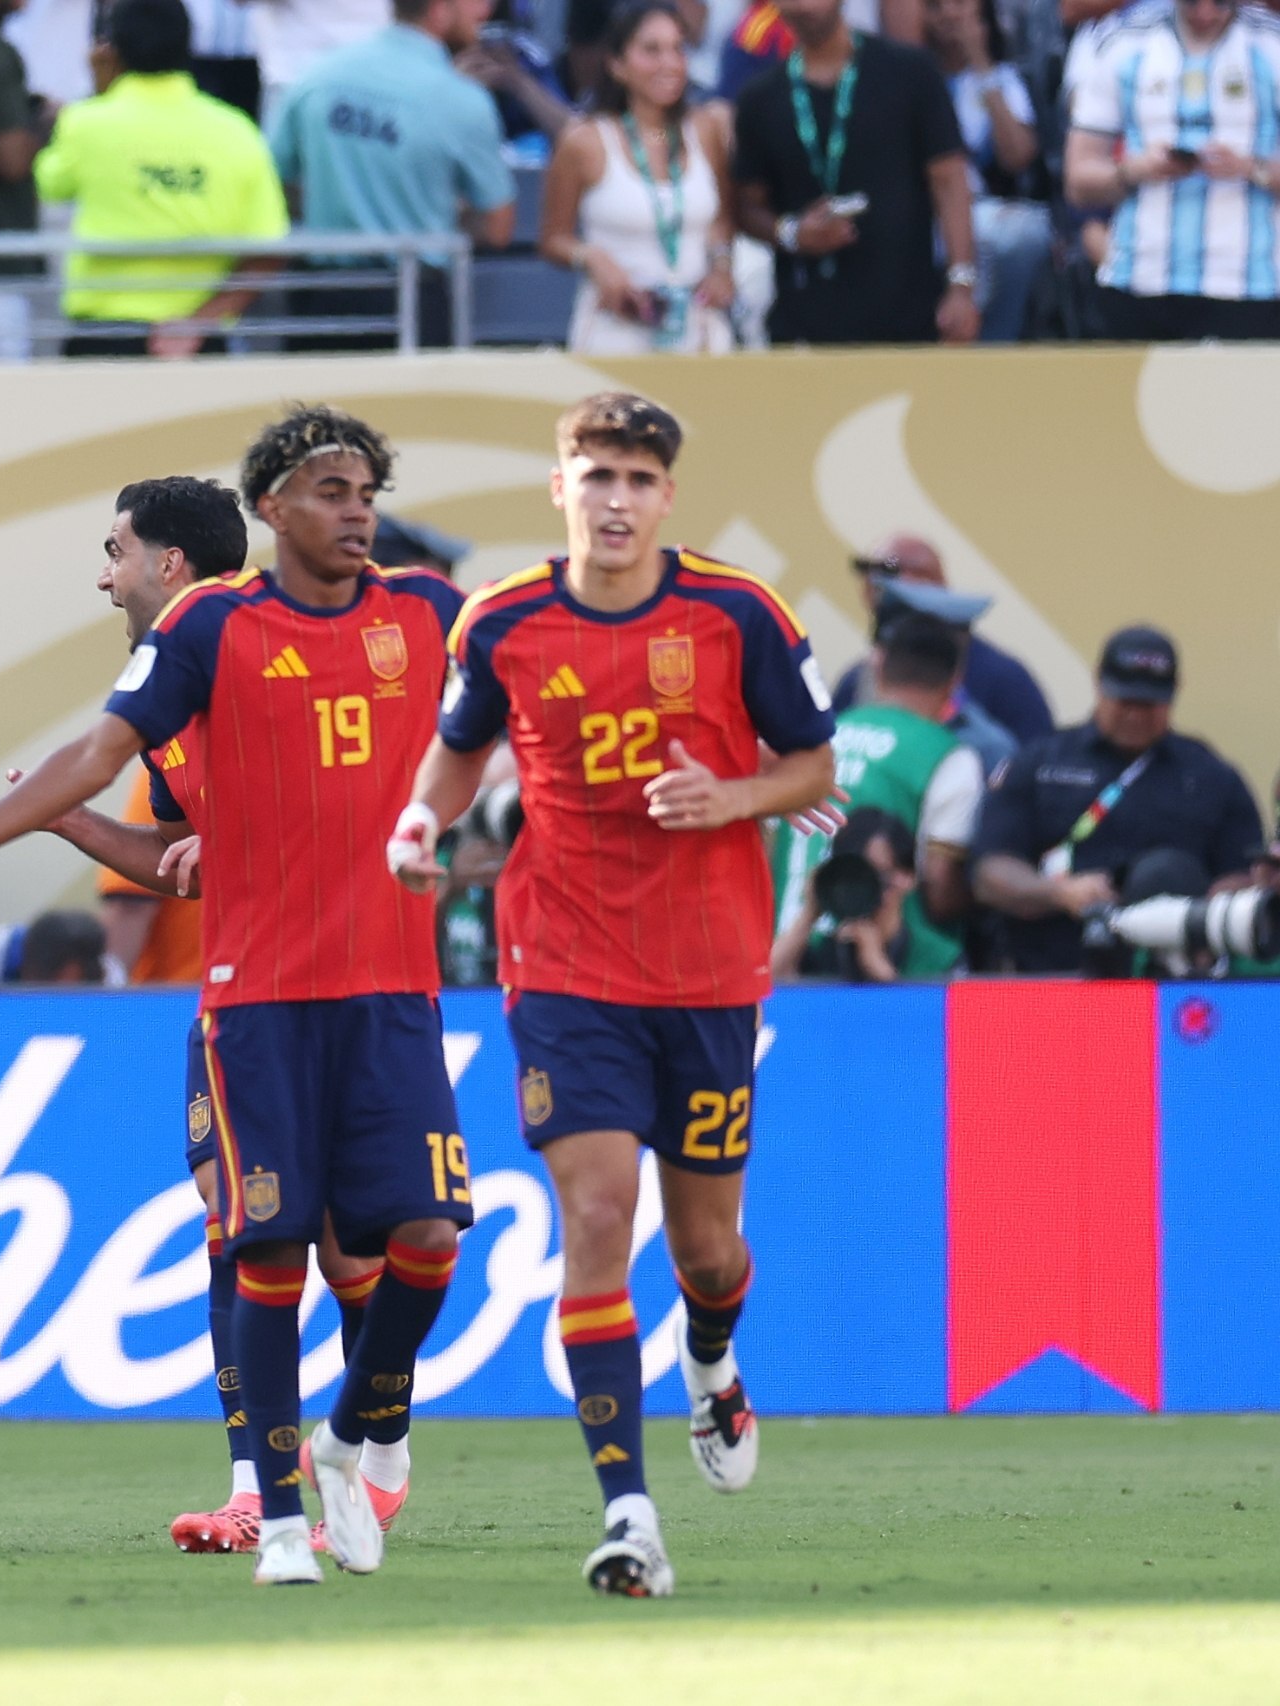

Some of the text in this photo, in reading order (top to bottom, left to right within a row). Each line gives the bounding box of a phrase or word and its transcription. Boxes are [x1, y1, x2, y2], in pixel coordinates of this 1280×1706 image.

[315, 696, 372, 767] 19
[580, 709, 663, 785] 22
[683, 1086, 751, 1160] 22
[426, 1132, 471, 1204] 19
